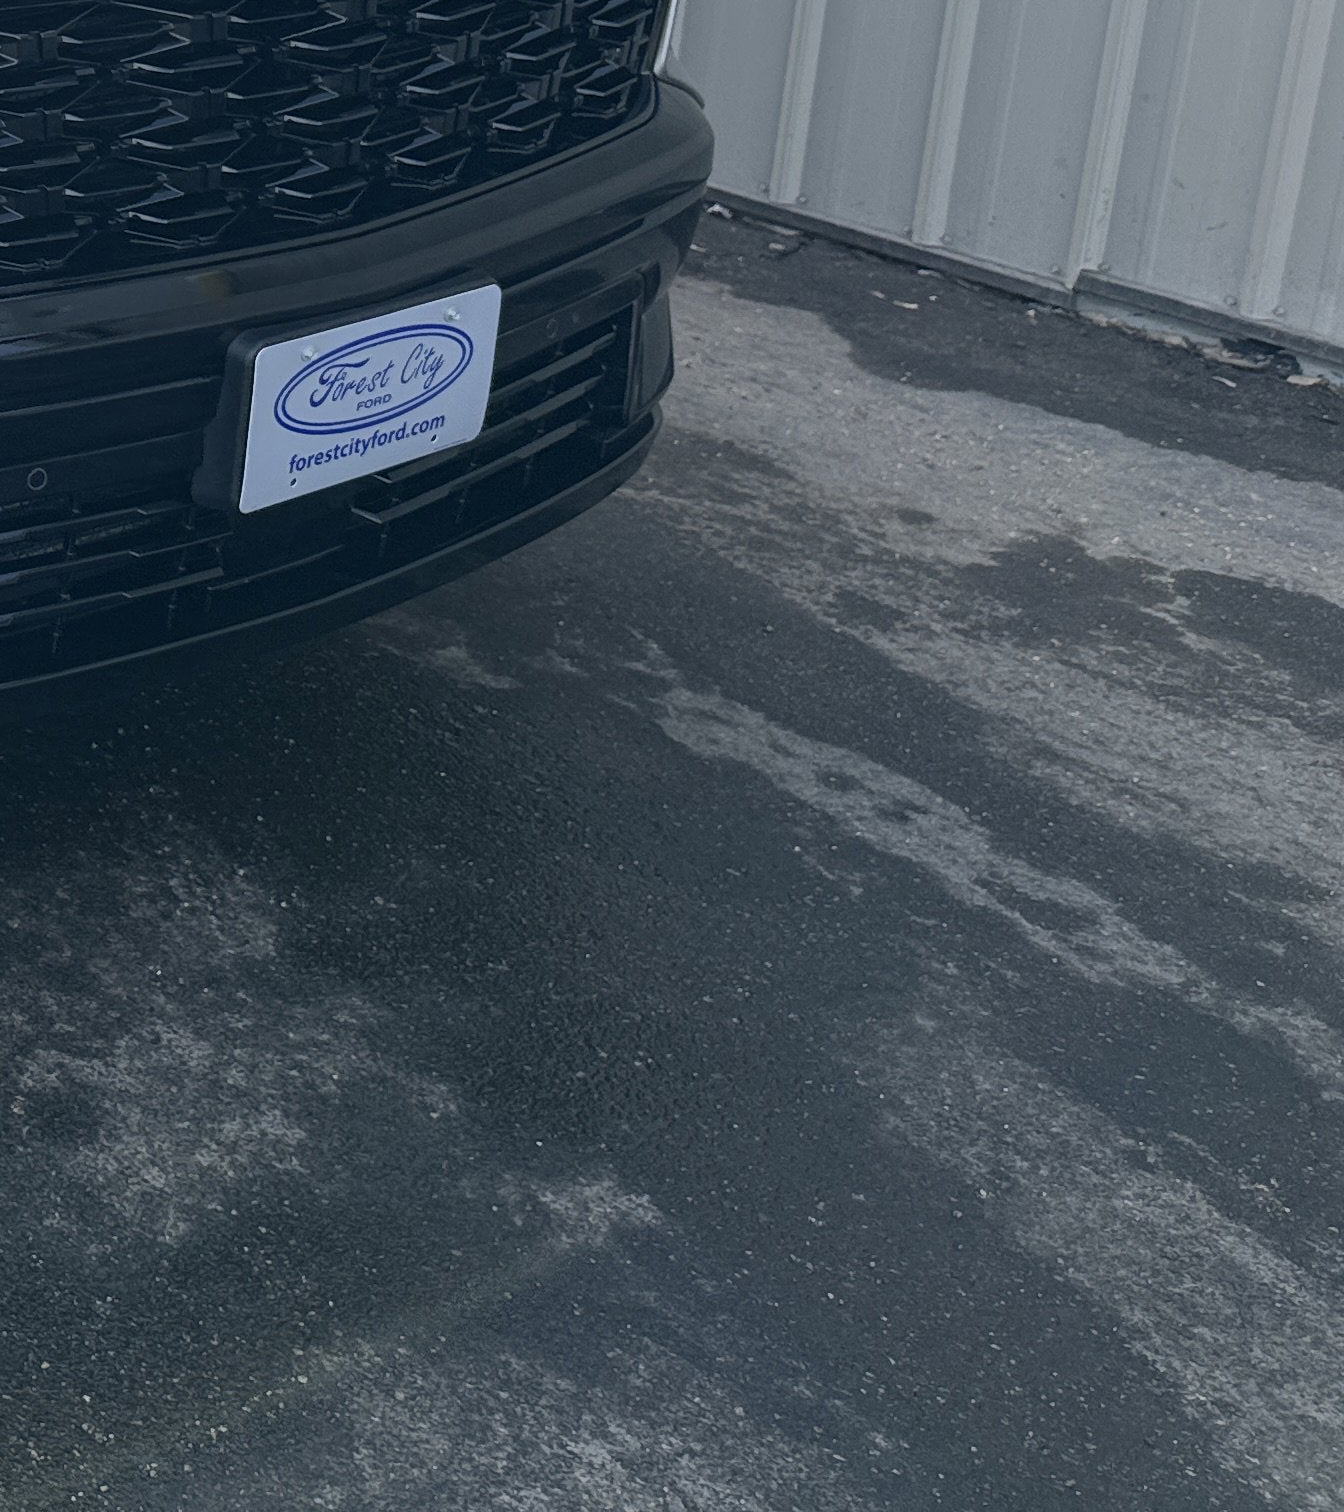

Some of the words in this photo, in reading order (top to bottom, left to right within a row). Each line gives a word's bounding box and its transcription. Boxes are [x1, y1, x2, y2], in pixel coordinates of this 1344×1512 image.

[309, 358, 394, 407] Forest
[401, 343, 443, 389] City
[356, 394, 392, 411] FORD
[289, 414, 445, 474] forestcityford.com
